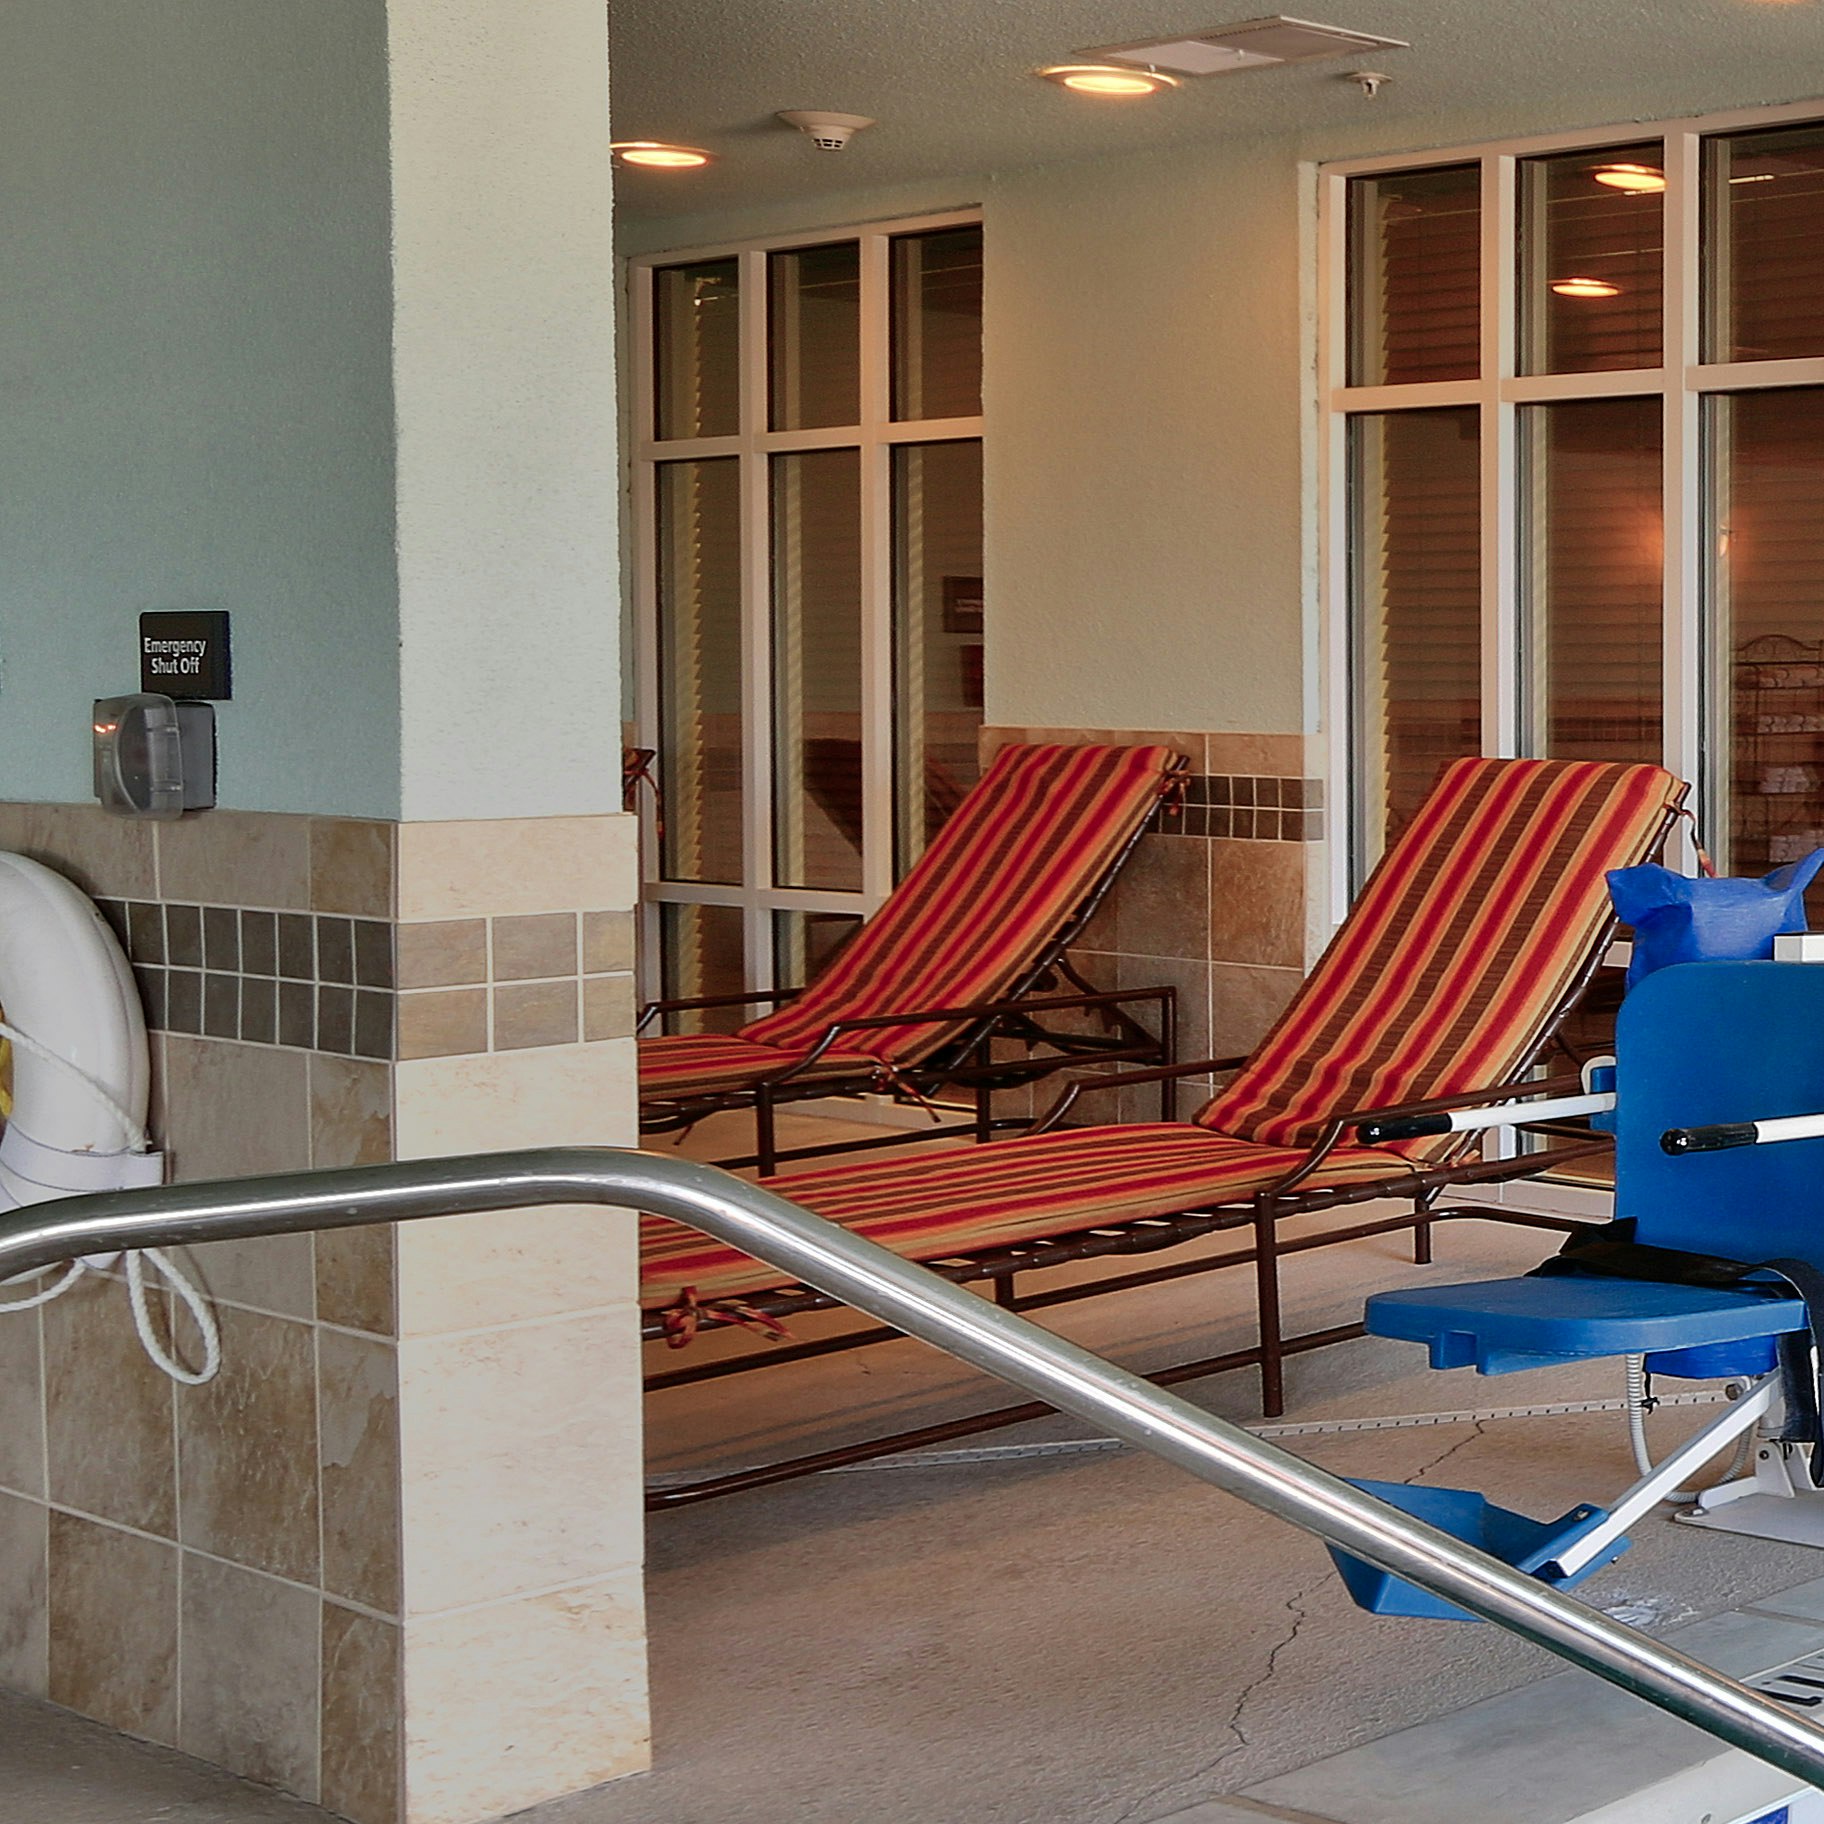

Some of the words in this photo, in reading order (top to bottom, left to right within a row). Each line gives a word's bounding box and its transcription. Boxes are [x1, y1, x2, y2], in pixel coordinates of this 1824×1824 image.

[144, 638, 207, 656] Emergency
[151, 657, 178, 674] Shut
[180, 657, 201, 674] Off
